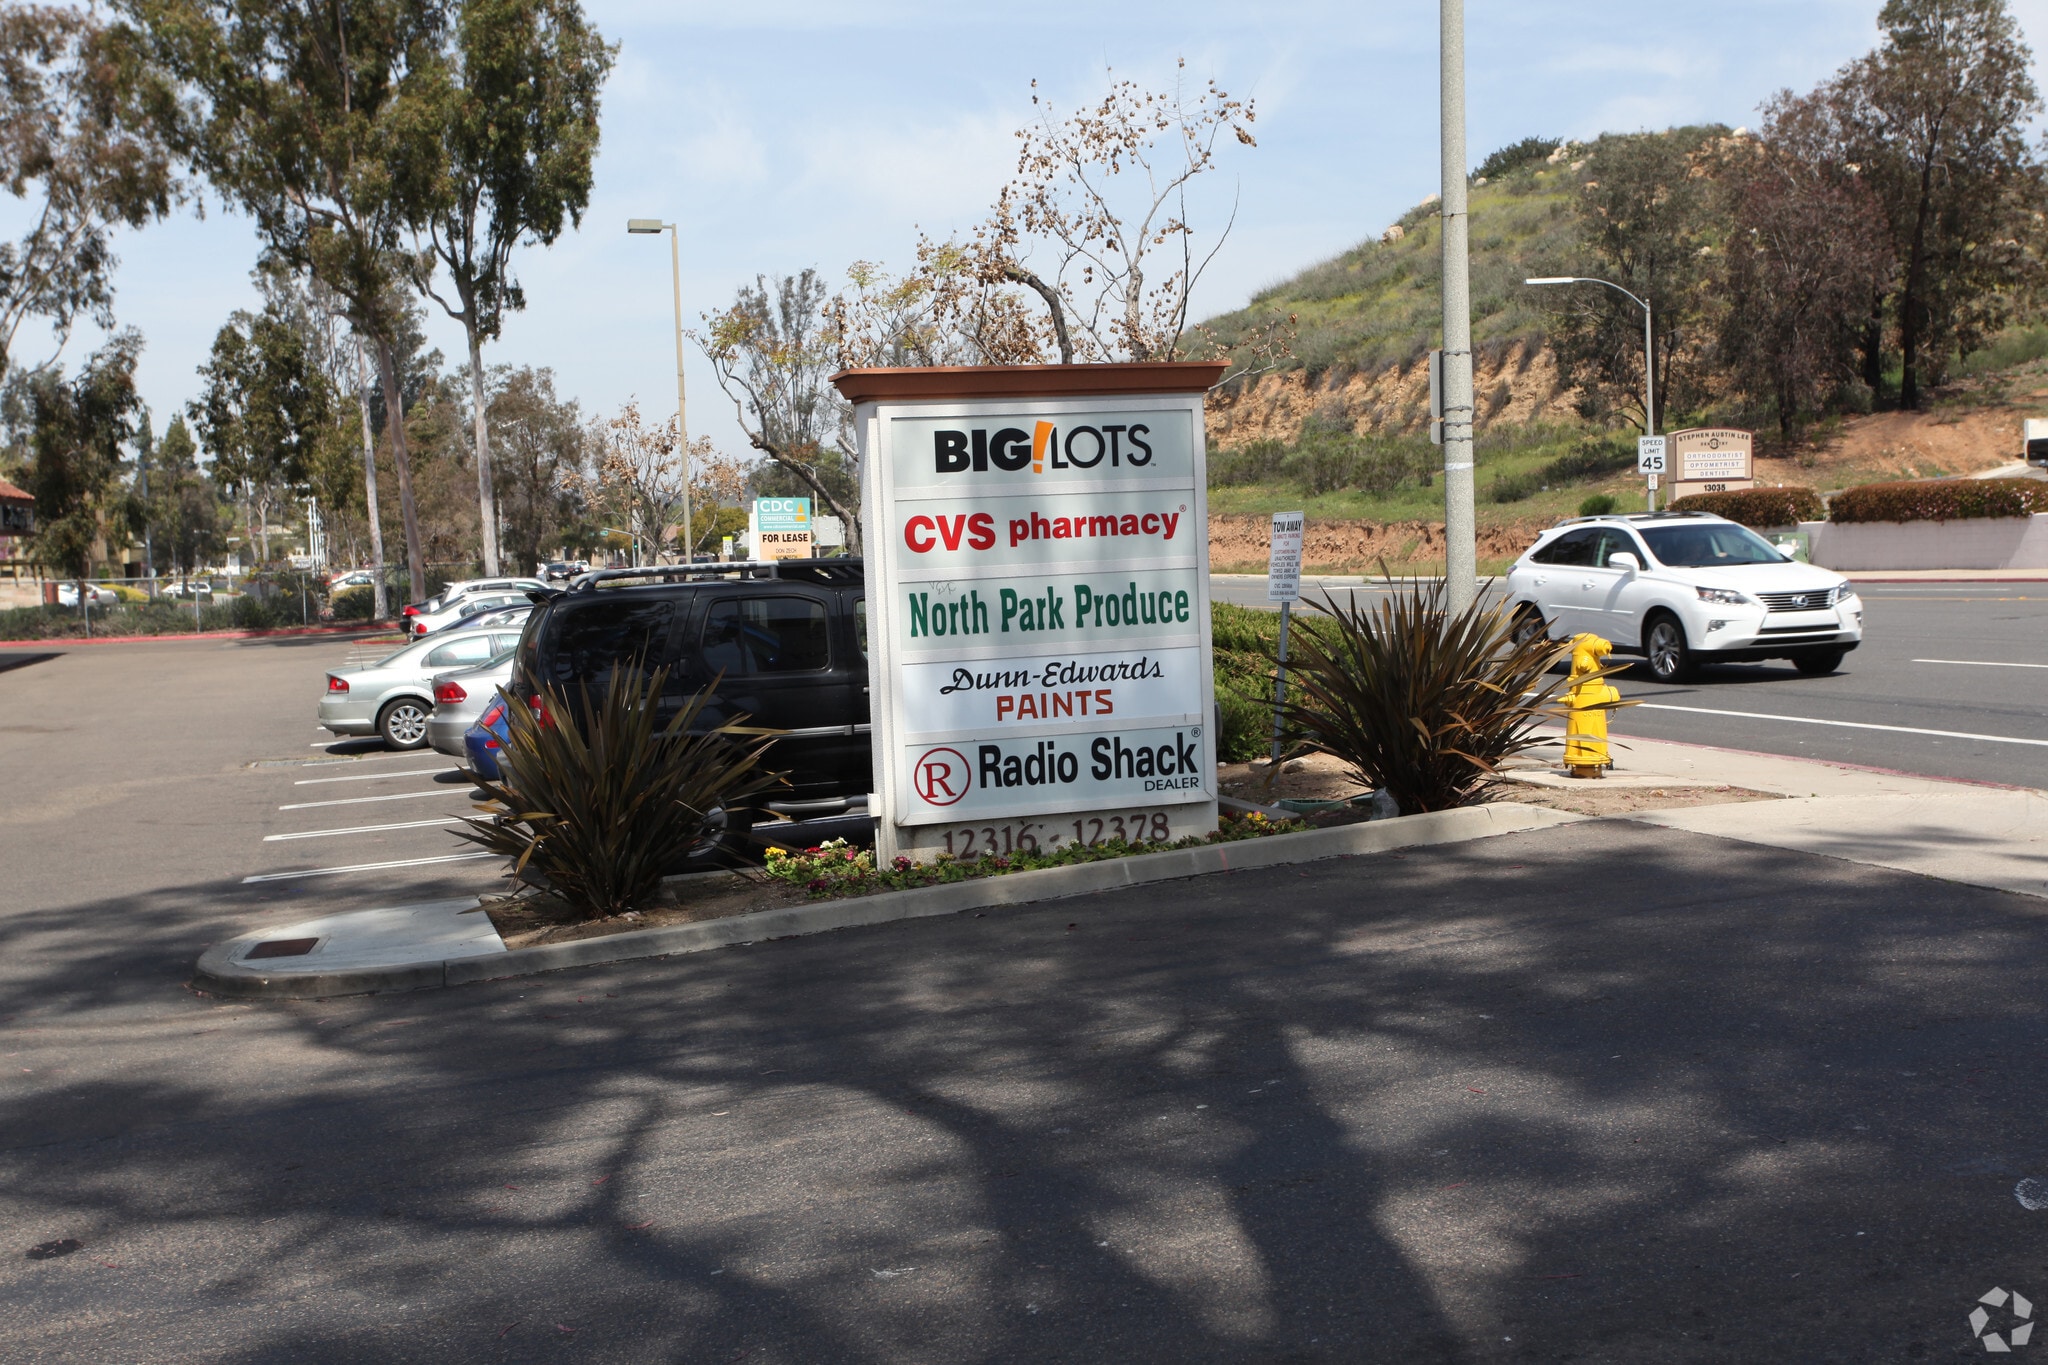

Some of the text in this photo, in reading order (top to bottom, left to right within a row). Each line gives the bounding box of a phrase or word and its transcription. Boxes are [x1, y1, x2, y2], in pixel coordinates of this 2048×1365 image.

[1679, 432, 1709, 442] STEPHEN
[1642, 457, 1663, 470] 45
[1704, 484, 1726, 492] 13035
[760, 500, 794, 513] CDC
[904, 511, 1180, 554] CVS pharmacy
[1274, 520, 1302, 533] TOW AWAY
[762, 533, 808, 543] FOR LEASE
[909, 581, 1190, 638] North Park Produce
[939, 655, 1165, 695] Dunn-Edwards
[996, 688, 1114, 722] PAINTS
[978, 731, 1198, 788] Radio Shack
[1144, 776, 1199, 792] DEALER
[1073, 812, 1170, 849] 12378
